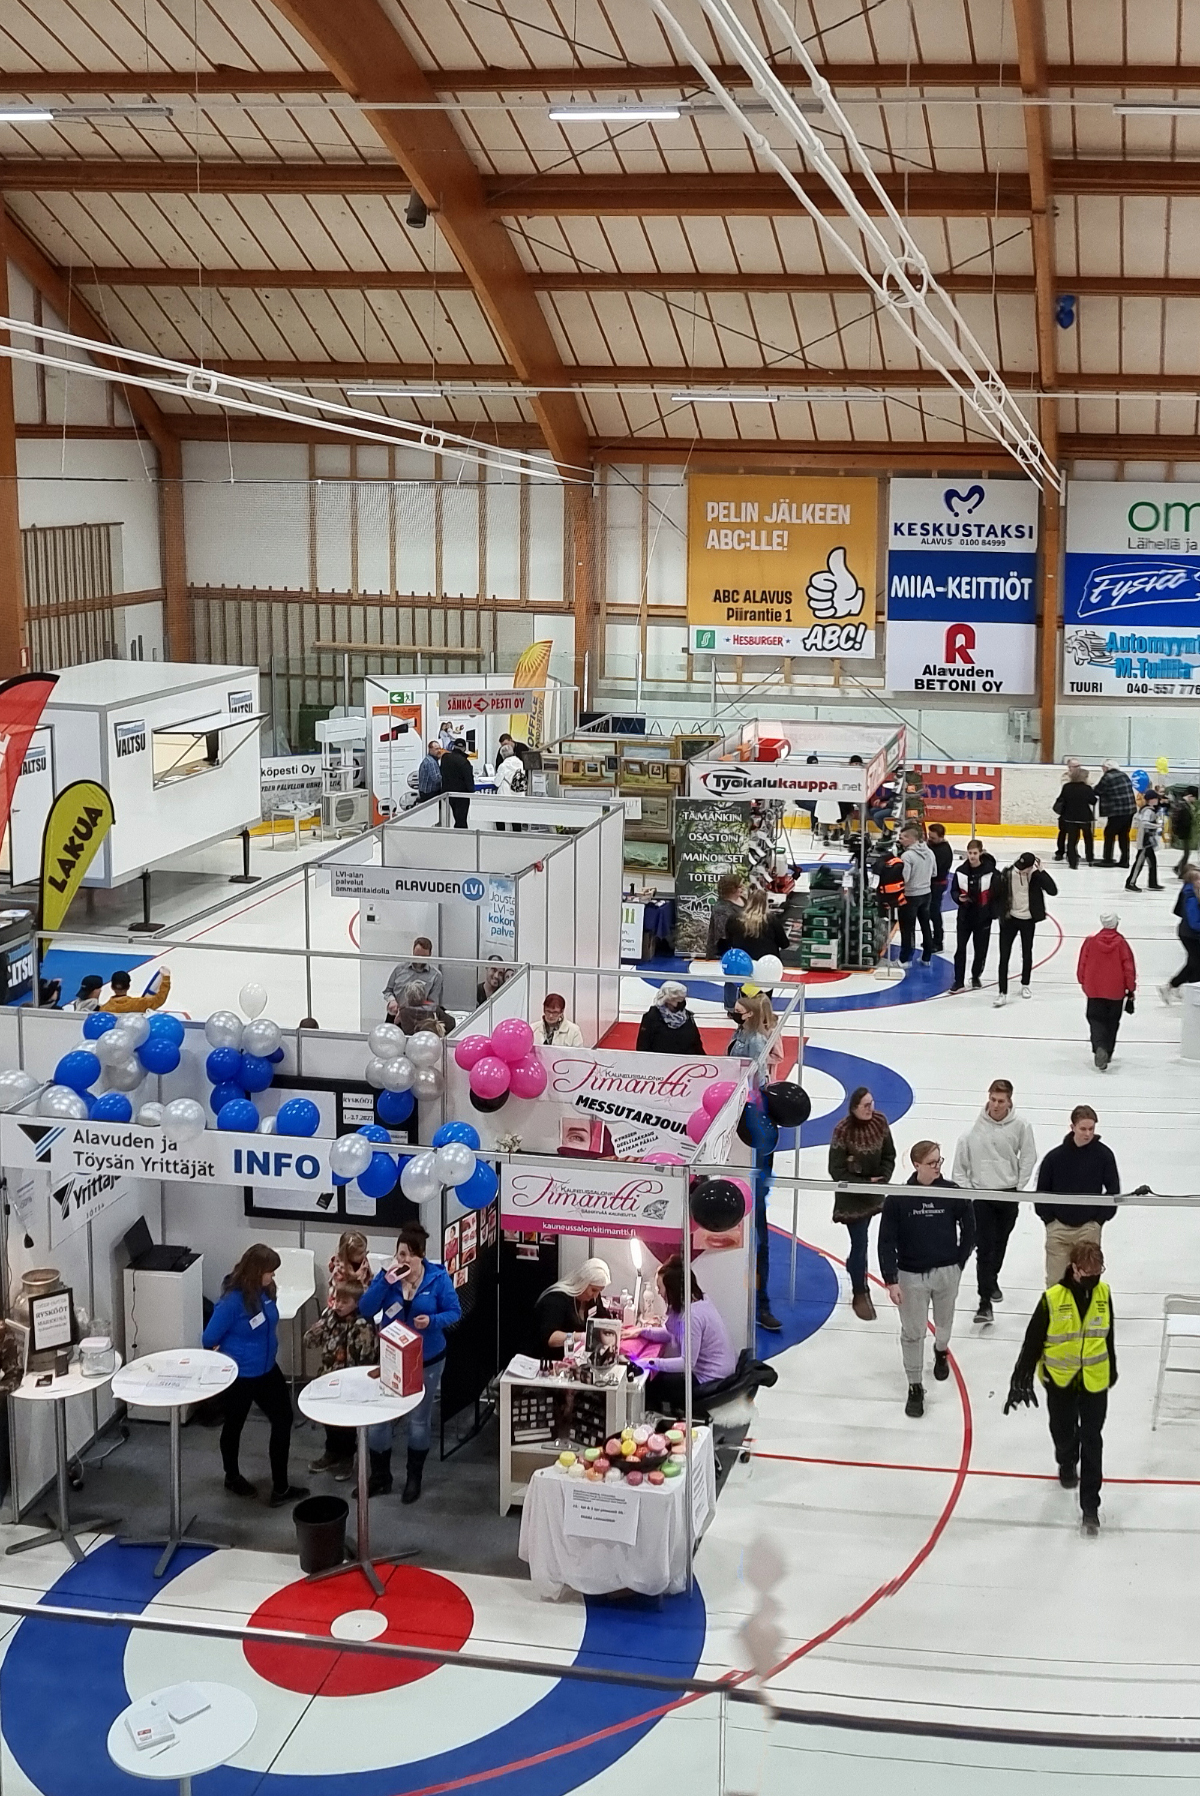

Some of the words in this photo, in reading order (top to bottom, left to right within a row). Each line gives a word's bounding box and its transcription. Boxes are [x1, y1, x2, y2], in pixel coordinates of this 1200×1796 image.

[706, 501, 758, 523] PELIN
[763, 499, 850, 525] JÄLKEEN
[893, 522, 1034, 540] KESKUSTAKSI
[706, 529, 789, 551] ABC:LLE!
[921, 538, 953, 546] ALAVUS
[1128, 537, 1181, 551] Lähellä
[1185, 538, 1199, 553] ja
[890, 571, 1033, 601] MIIA-KEITTIÖT
[714, 590, 740, 604] ABC
[743, 590, 793, 605] ALAVUS
[726, 607, 782, 622] Piirantie
[785, 608, 793, 622] 1
[732, 634, 784, 647] HESBURGER
[803, 622, 867, 651] ABC!
[922, 665, 994, 678] Alavuden
[914, 679, 976, 692] BETONI
[981, 680, 1003, 693] OY
[1069, 681, 1103, 693] TUURI
[490, 698, 512, 709] PESTI
[514, 698, 526, 709] OY
[116, 733, 147, 758] VALTSU
[301, 764, 316, 776] Oy
[683, 811, 742, 822] TÄMÄNKIN
[688, 833, 738, 842] OSASTON
[48, 806, 103, 893] LAKUA
[682, 853, 743, 863] MAINOKSET
[335, 870, 364, 879] LVI-alan
[688, 873, 722, 883] TOTEU
[335, 878, 364, 887] palvelut
[395, 880, 461, 894] ALAVUDEN
[464, 884, 483, 895] LVI
[335, 886, 390, 895] ammattitaidolla
[552, 1057, 719, 1099] Timantti
[73, 1129, 154, 1150] Alavuden
[161, 1134, 178, 1155] ja
[74, 1151, 135, 1174] Töysän
[140, 1155, 216, 1179] Yrittäjät
[234, 1149, 321, 1180] INFO
[512, 1174, 663, 1212] Timantti
[542, 1221, 637, 1237] kauneussalonkitimantti.fi
